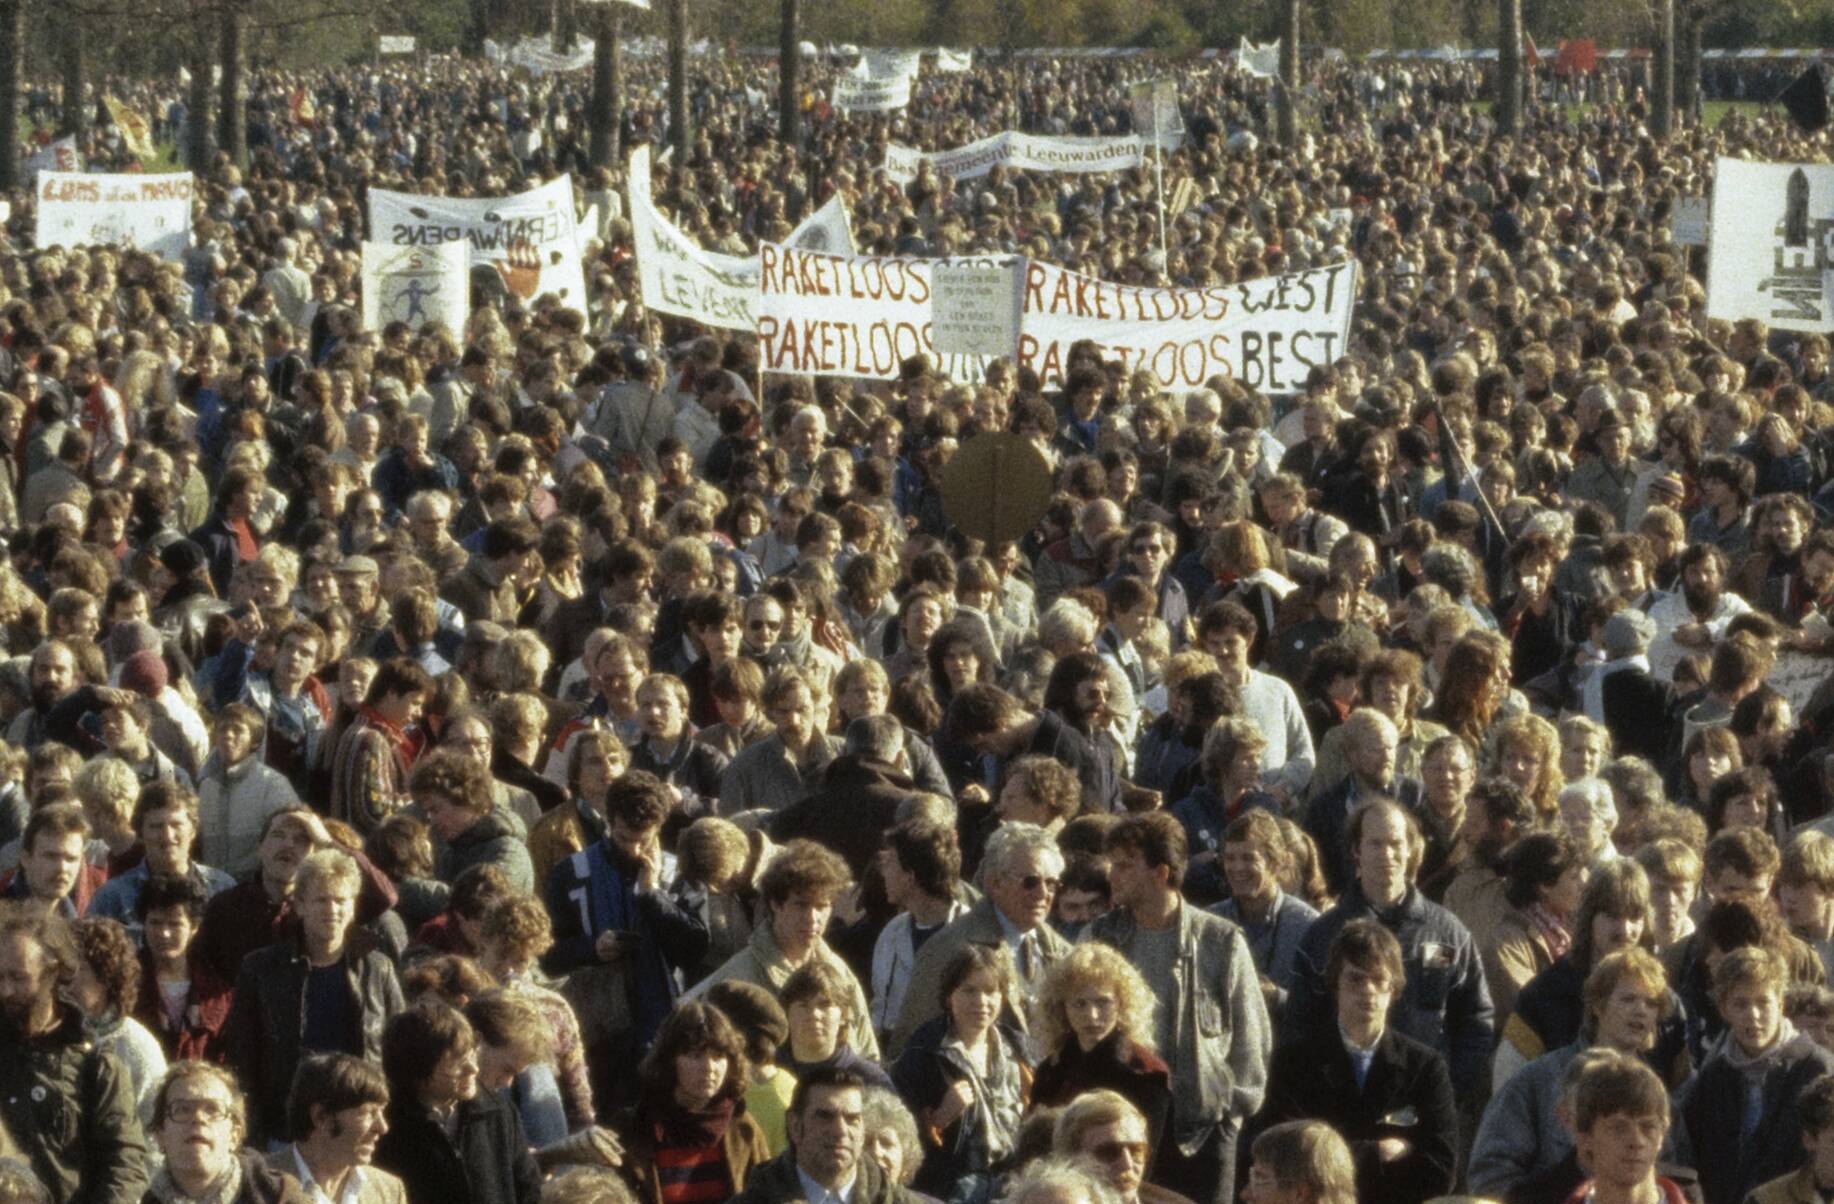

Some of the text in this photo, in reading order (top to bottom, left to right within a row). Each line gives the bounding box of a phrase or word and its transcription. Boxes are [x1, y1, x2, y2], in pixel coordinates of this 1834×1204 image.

[1026, 142, 1138, 163] Leeuwarden
[761, 244, 930, 305] RAKETLOOS
[1023, 263, 1347, 322] RAKETLOOS WEST
[1241, 330, 1340, 390] BEST
